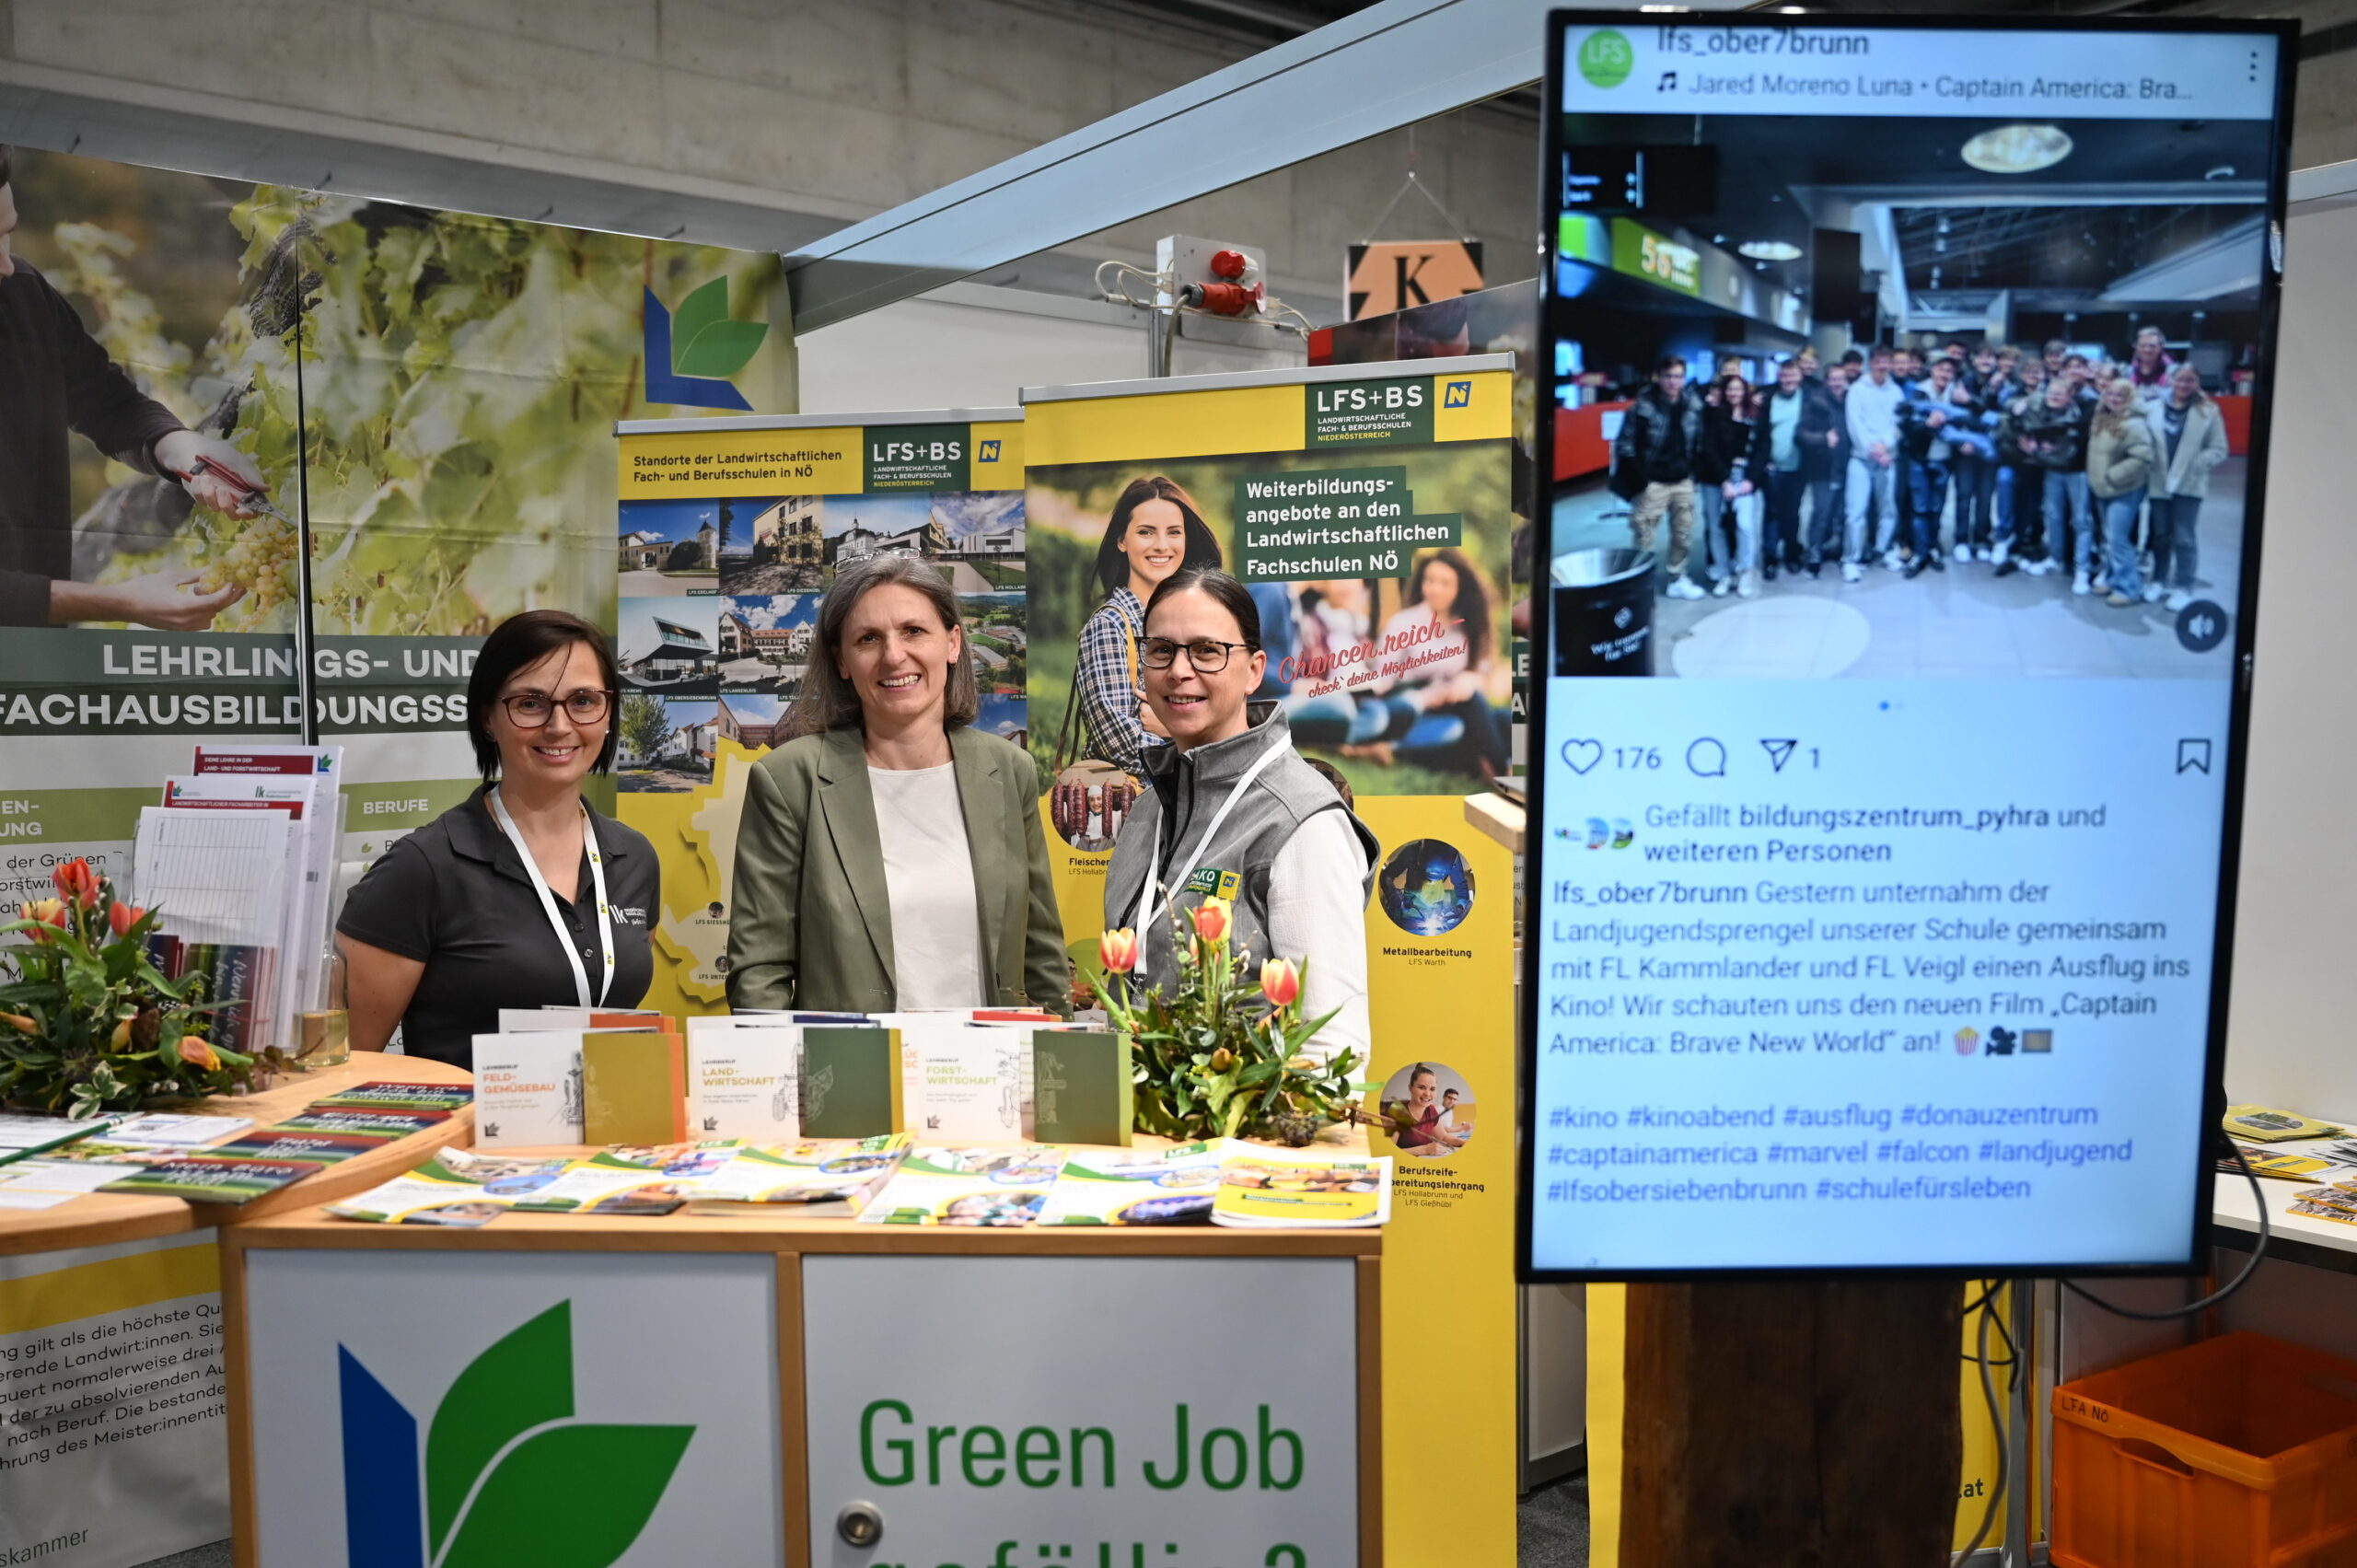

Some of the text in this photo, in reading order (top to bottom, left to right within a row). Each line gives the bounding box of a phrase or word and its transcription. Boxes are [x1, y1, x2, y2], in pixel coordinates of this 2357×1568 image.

[1586, 39, 1627, 64] LFS
[1658, 28, 1871, 55] lfs_ober7brunn
[1689, 75, 1753, 96] Jared
[1762, 75, 1851, 97] Moreno
[1858, 75, 1913, 98] Luna
[1936, 75, 2024, 100] Captain
[2030, 77, 2131, 99] America:
[1393, 256, 1437, 309] K
[1318, 385, 1423, 412] LFS+BS
[1318, 412, 1406, 424] LANDWIRTSCHAFTLICHE
[1348, 421, 1411, 431] BERUFSSCHULEN
[1318, 431, 1390, 441] NIEDERÖSTERREICH
[633, 450, 842, 467] Standorte der Landwirtschaftlichen
[874, 442, 961, 461] LFS+BS
[633, 464, 813, 482] Fach- und Berufsschulen in NÖ
[1247, 478, 1394, 499] Weiterbildungs-
[1247, 501, 1400, 526] angebote an den
[1247, 524, 1449, 548] Landwirtschaftlichen
[1247, 551, 1399, 575] Fachschulen NÖ
[103, 645, 389, 678] LEHRLINGS-
[1347, 639, 1468, 687] deine Möglichkeiten!
[0, 693, 469, 726] ACHAUSBILDUNGSS
[1613, 747, 1820, 770] 176 1
[363, 798, 429, 815] BERUFE
[1645, 805, 2107, 832] Gefällt bildungszentrum_pyhra und
[6, 855, 35, 869] der
[1644, 840, 1892, 863] weiteren Personen
[1554, 881, 2050, 906] lfs_ober7brunn Gestern unternahm der
[1553, 919, 2167, 947] Landjugendsprengel unserer Schule gemeinsam
[1383, 947, 1472, 958] Metallbearbeitung
[1551, 955, 2191, 983] mit FL Kammlander und FL Veigl einen Ausflug ins
[1550, 994, 1615, 1017] Kino!
[1622, 994, 1665, 1016] Wir
[1671, 994, 1788, 1016] schauten
[1795, 999, 1842, 1016] uns
[1849, 993, 1897, 1016] den
[1904, 998, 1982, 1016] neuen
[1990, 993, 2044, 1016] Film
[1549, 1032, 1661, 1054] America:
[1669, 1032, 1741, 1054] Brave
[1749, 1032, 1807, 1053] New
[1902, 1030, 1941, 1053] an!
[483, 1073, 517, 1082] FELD-
[702, 1067, 739, 1076] LAND-
[702, 1076, 775, 1086] WIRTSCHAFT
[926, 1066, 967, 1074] FORST-
[927, 1076, 998, 1085] WIRTSCHAFT
[483, 1082, 555, 1094] GEMÜSEBAU
[1549, 1104, 2098, 1133] #kino #kinoabend #ausflug #donauzentrum
[1548, 1139, 2133, 1168] #captainamerica #marvel #falcon #landjugend
[1399, 1166, 1457, 1177] Berufsreife-
[1409, 1190, 1448, 1198] Hollabrunn
[1547, 1177, 2032, 1202] #lfsobersiebenbrunn #schulefürsleben
[1420, 1199, 1452, 1208] Gießhübl
[25, 1339, 54, 1358] gilt
[61, 1332, 86, 1347] als
[91, 1325, 117, 1341] die
[122, 1310, 191, 1333] höchste
[64, 1332, 193, 1368] Landwirt:innen.
[199, 1323, 224, 1337] Sie
[52, 1356, 178, 1393] normalerweise
[182, 1343, 214, 1362] drei
[9, 1369, 200, 1423] der zu absolvierenden
[7, 1426, 51, 1447] nach
[57, 1411, 110, 1434] Beruf.
[116, 1404, 144, 1420] Die
[56, 1437, 88, 1455] des
[859, 1399, 1305, 1493] Green Job
